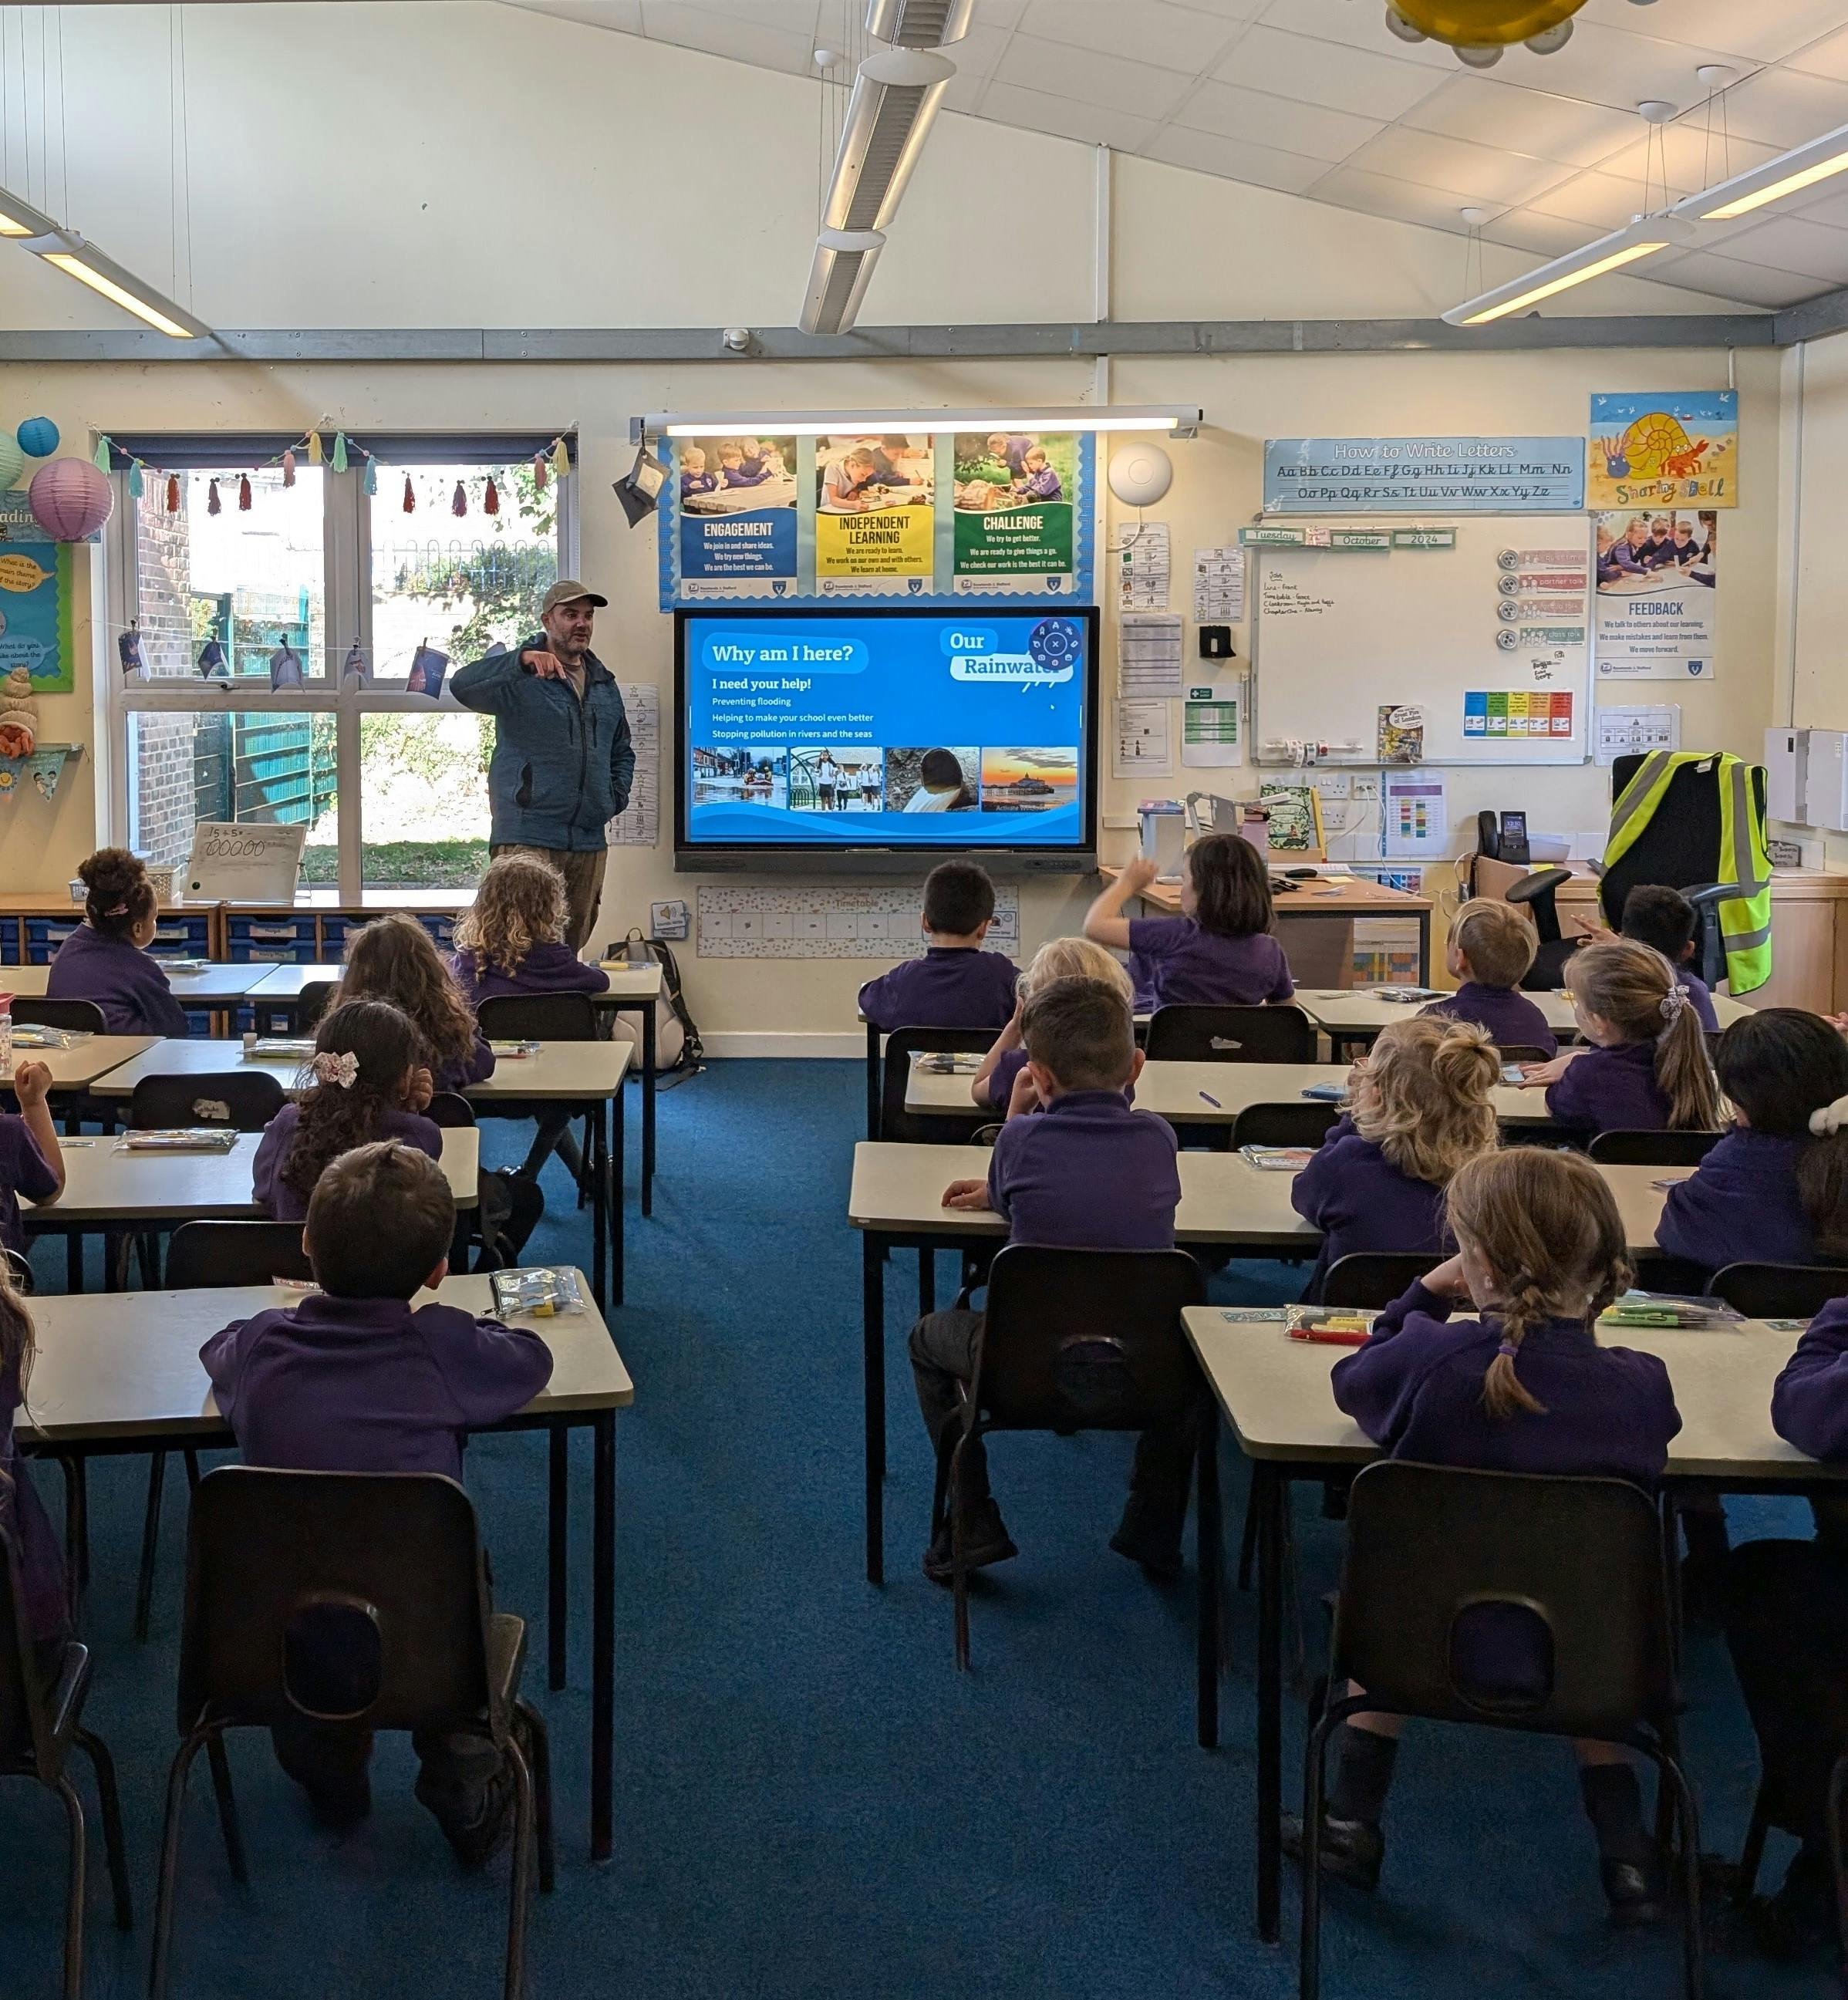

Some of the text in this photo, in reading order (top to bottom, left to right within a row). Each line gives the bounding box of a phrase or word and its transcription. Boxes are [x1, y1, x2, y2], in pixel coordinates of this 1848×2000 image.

[1334, 443, 1517, 459] How to Write Letters
[1277, 464, 1573, 479] Aa Bb Cc Dd Ee Ff Gg Hh Ii Jj Kk Ll Mm Nn
[1298, 486, 1551, 501] Oo Pp Qq Rr Ss Tt Uu Vv Ww Xx Yy Zz
[1617, 478, 1724, 504] Sharing Shell
[704, 523, 773, 537] ENGAGEMENT
[840, 516, 910, 530] INDEPENDENT
[983, 516, 1044, 530] CHALLENGE
[849, 531, 900, 544] LEARNING
[1253, 531, 1297, 541] Tuesday
[1344, 536, 1381, 545] October
[1411, 535, 1438, 544] 2024
[1629, 602, 1684, 616] FEEDBACK
[950, 633, 984, 649] Our
[712, 646, 854, 665] Why am I here?
[713, 678, 811, 692] I need your help!
[713, 697, 791, 707] Preventing flooding
[713, 714, 744, 723] Helping
[755, 713, 777, 722] make
[799, 713, 826, 722] school
[848, 713, 874, 722] better
[713, 730, 750, 740] Stopping
[750, 730, 787, 740] pollution
